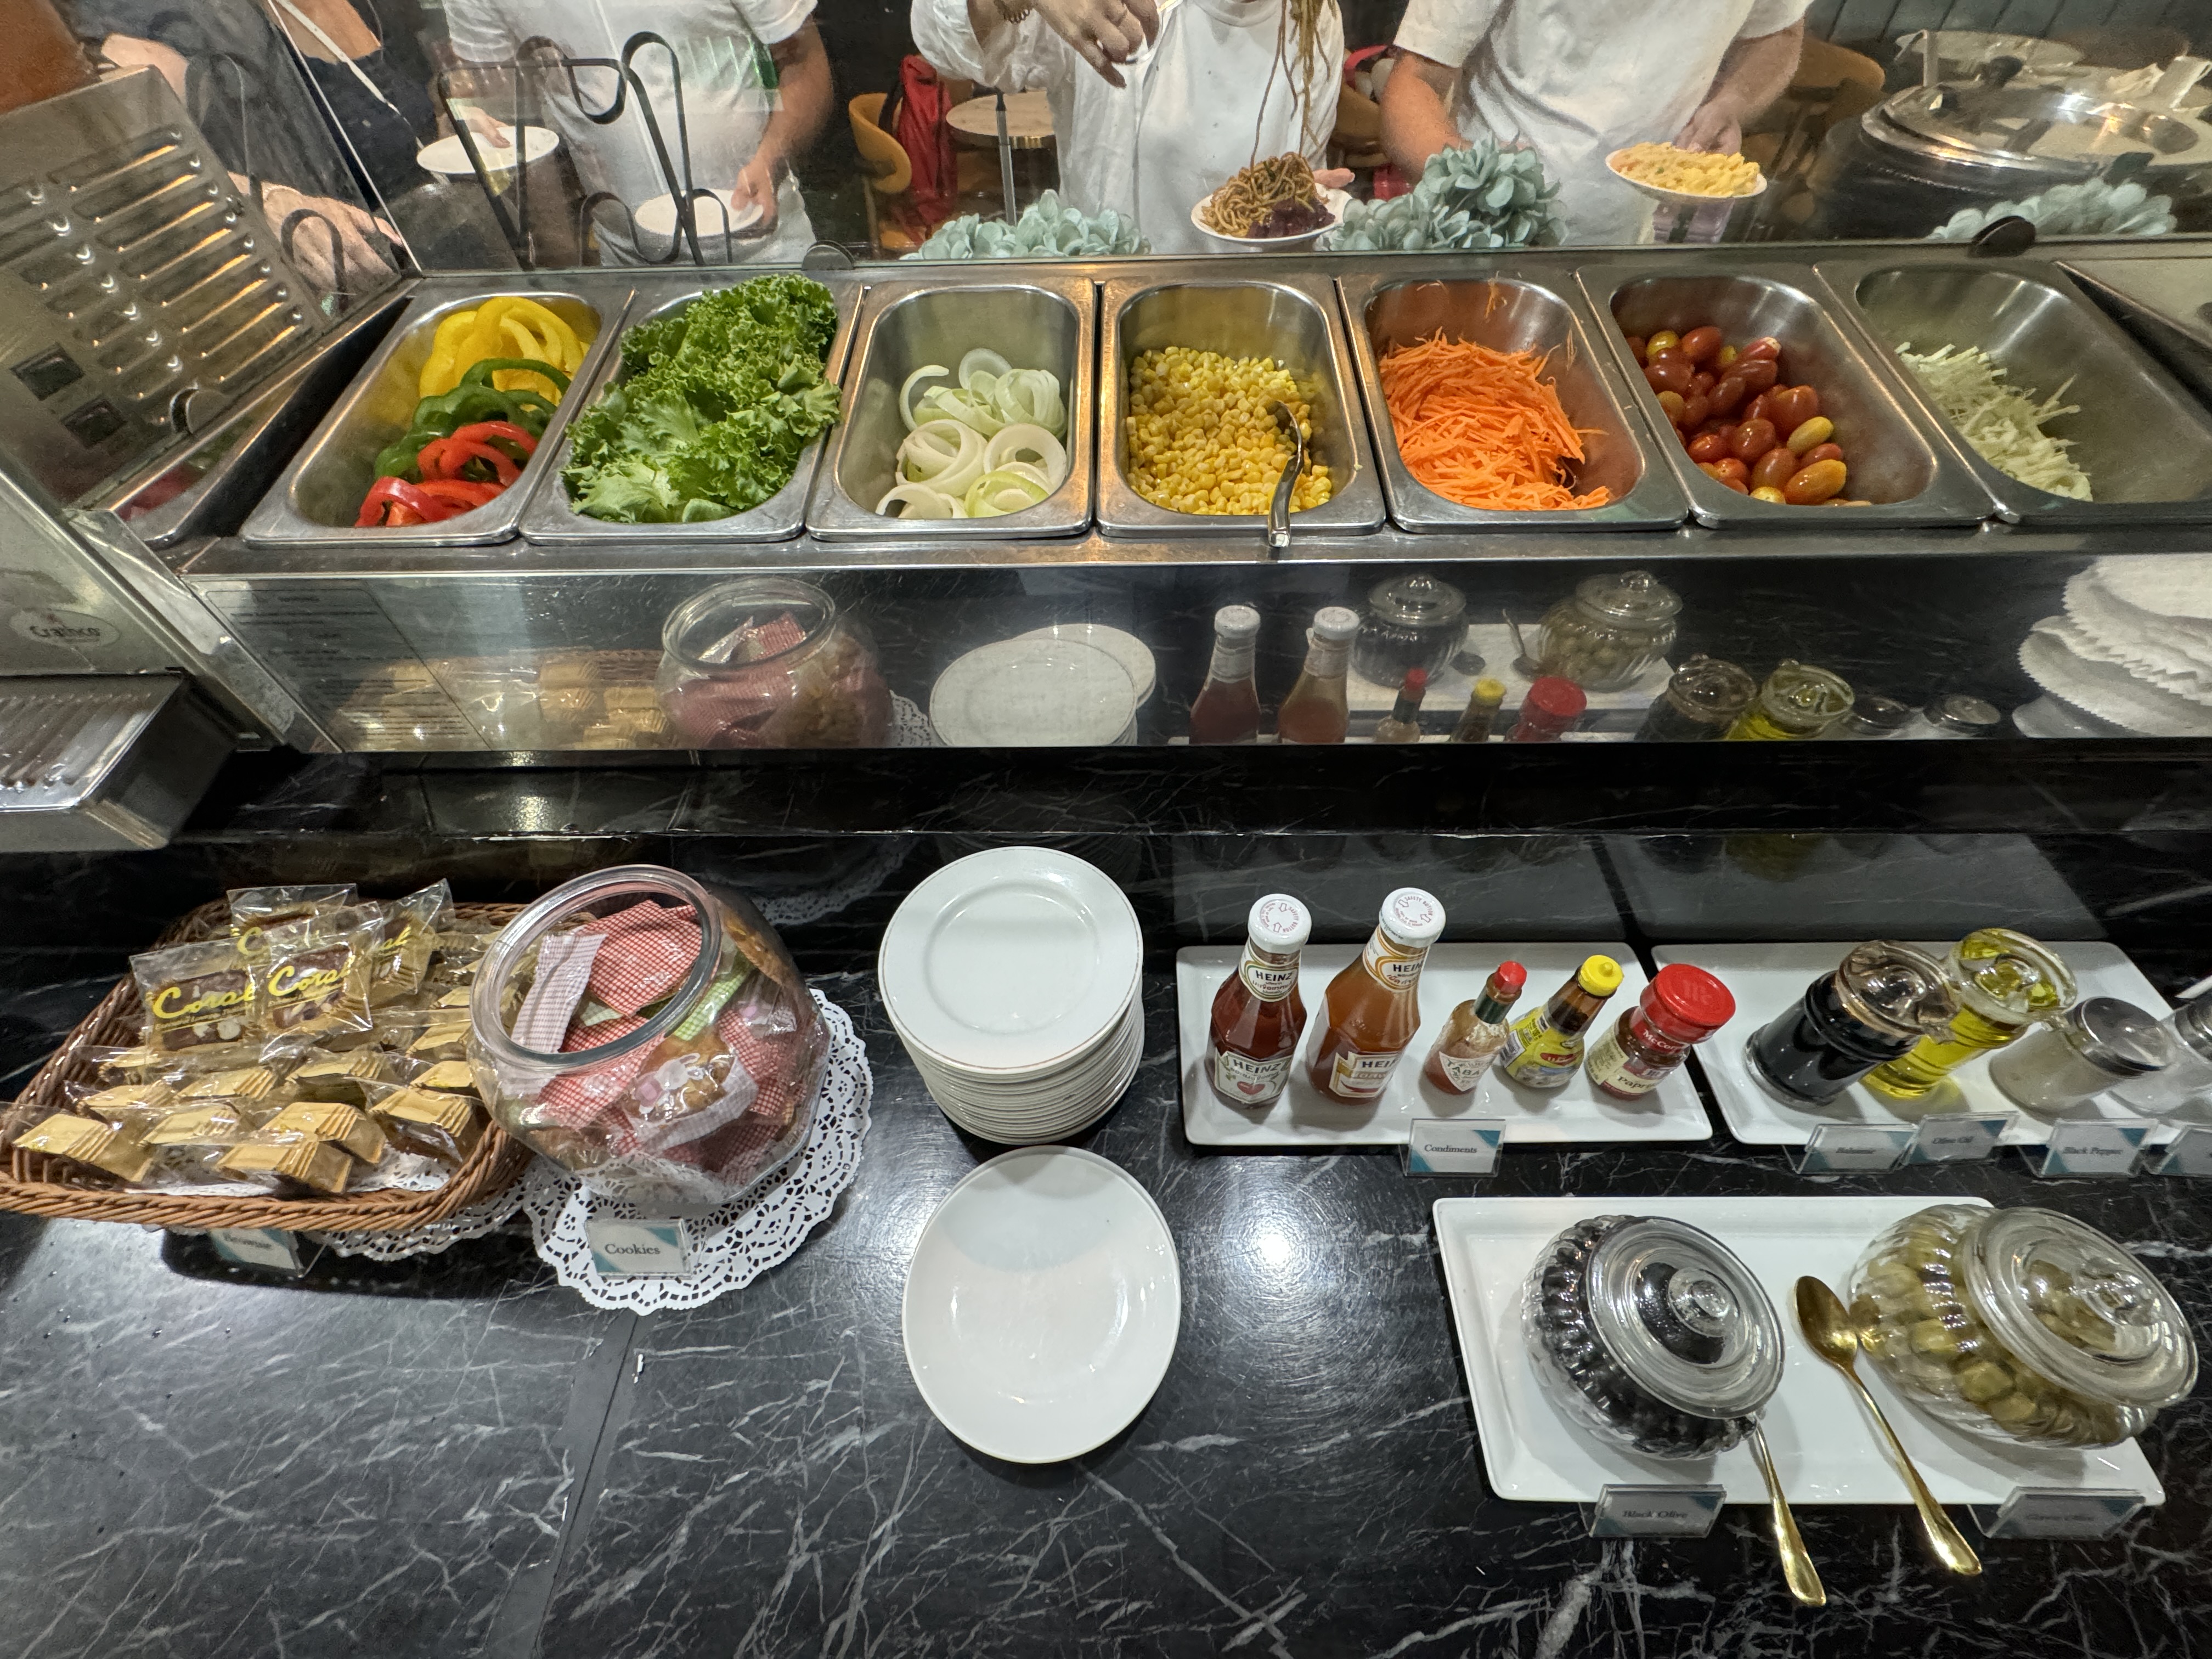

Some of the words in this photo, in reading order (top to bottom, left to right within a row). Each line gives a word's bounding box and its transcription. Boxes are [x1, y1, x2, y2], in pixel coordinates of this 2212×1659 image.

[1288, 906, 1299, 921] SAFETY
[1393, 961, 1423, 972] HEIN
[1256, 970, 1293, 981] HEINZ
[1643, 1029, 1678, 1050] McCor
[1233, 1059, 1282, 1074] HEINZ
[1362, 1059, 1397, 1068] HEI
[1447, 1059, 1480, 1076] TABA
[1424, 1144, 1477, 1153] Condiments
[605, 1243, 661, 1255] Cookies
[1622, 1510, 1653, 1518] Black
[1657, 1510, 1689, 1519] Olive
